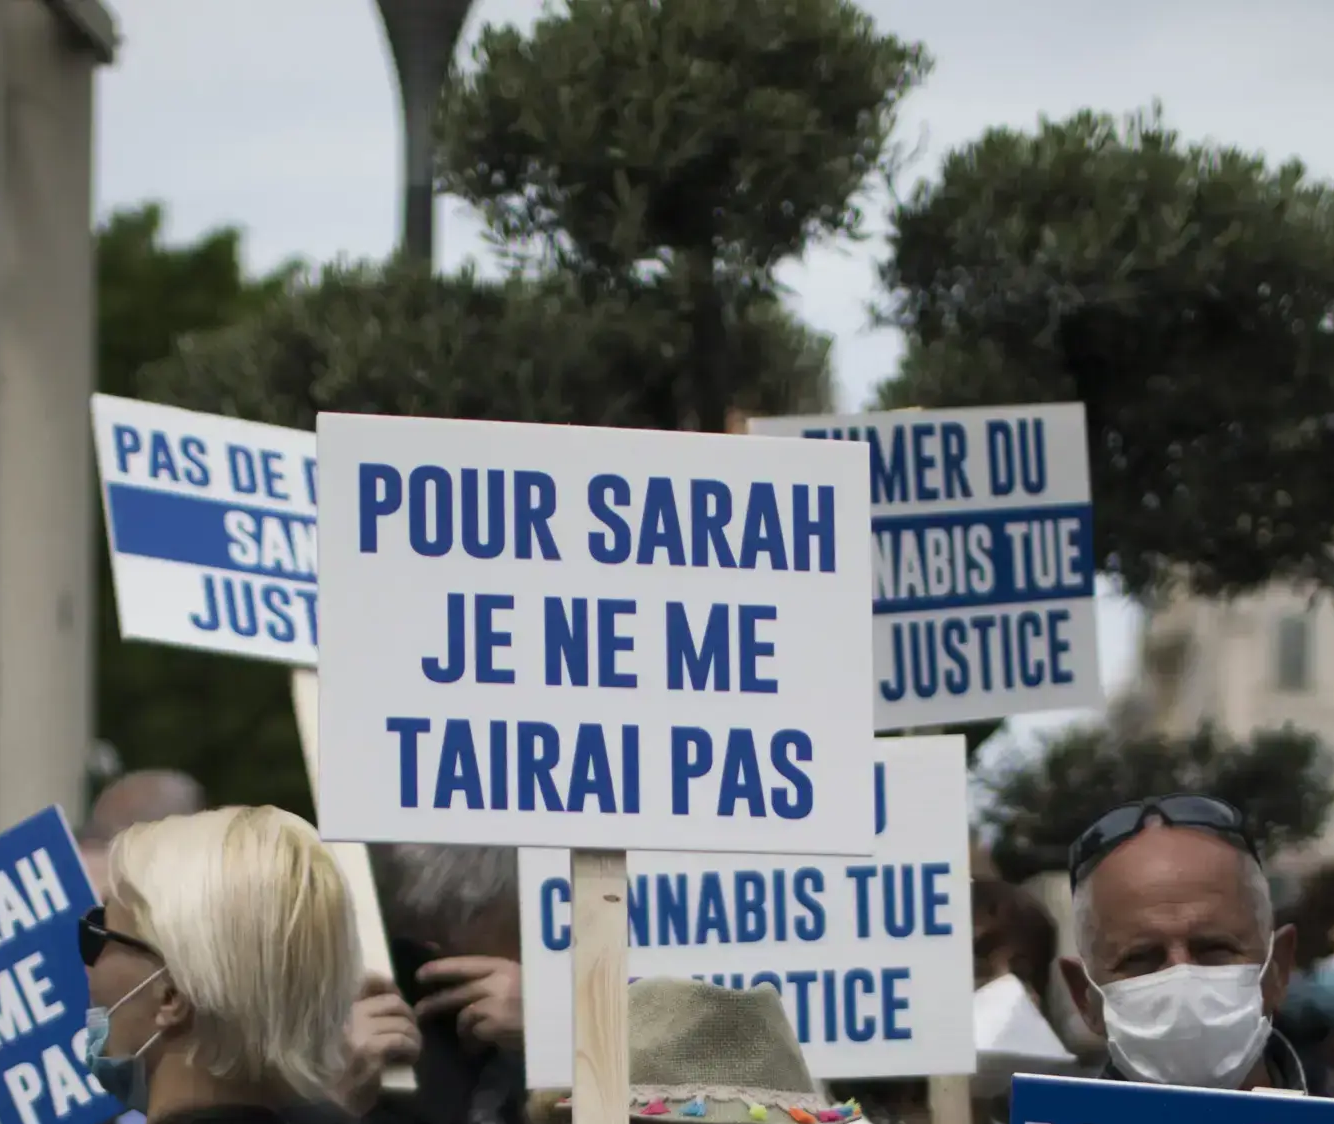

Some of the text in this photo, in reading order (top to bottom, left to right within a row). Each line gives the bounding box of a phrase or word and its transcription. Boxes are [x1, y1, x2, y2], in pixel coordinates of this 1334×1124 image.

[113, 422, 210, 487] PAS
[225, 443, 290, 500] DE
[801, 418, 1046, 504] MER DU
[359, 462, 561, 561] POUR
[587, 473, 836, 573] SARAH
[1005, 518, 1084, 591] TUE
[421, 592, 779, 694] JE NE ME
[880, 608, 1073, 703] JUSTICE
[386, 717, 640, 814] TAIRAI
[671, 726, 814, 820] PAS
[540, 862, 953, 951] CNNABIS TUE
